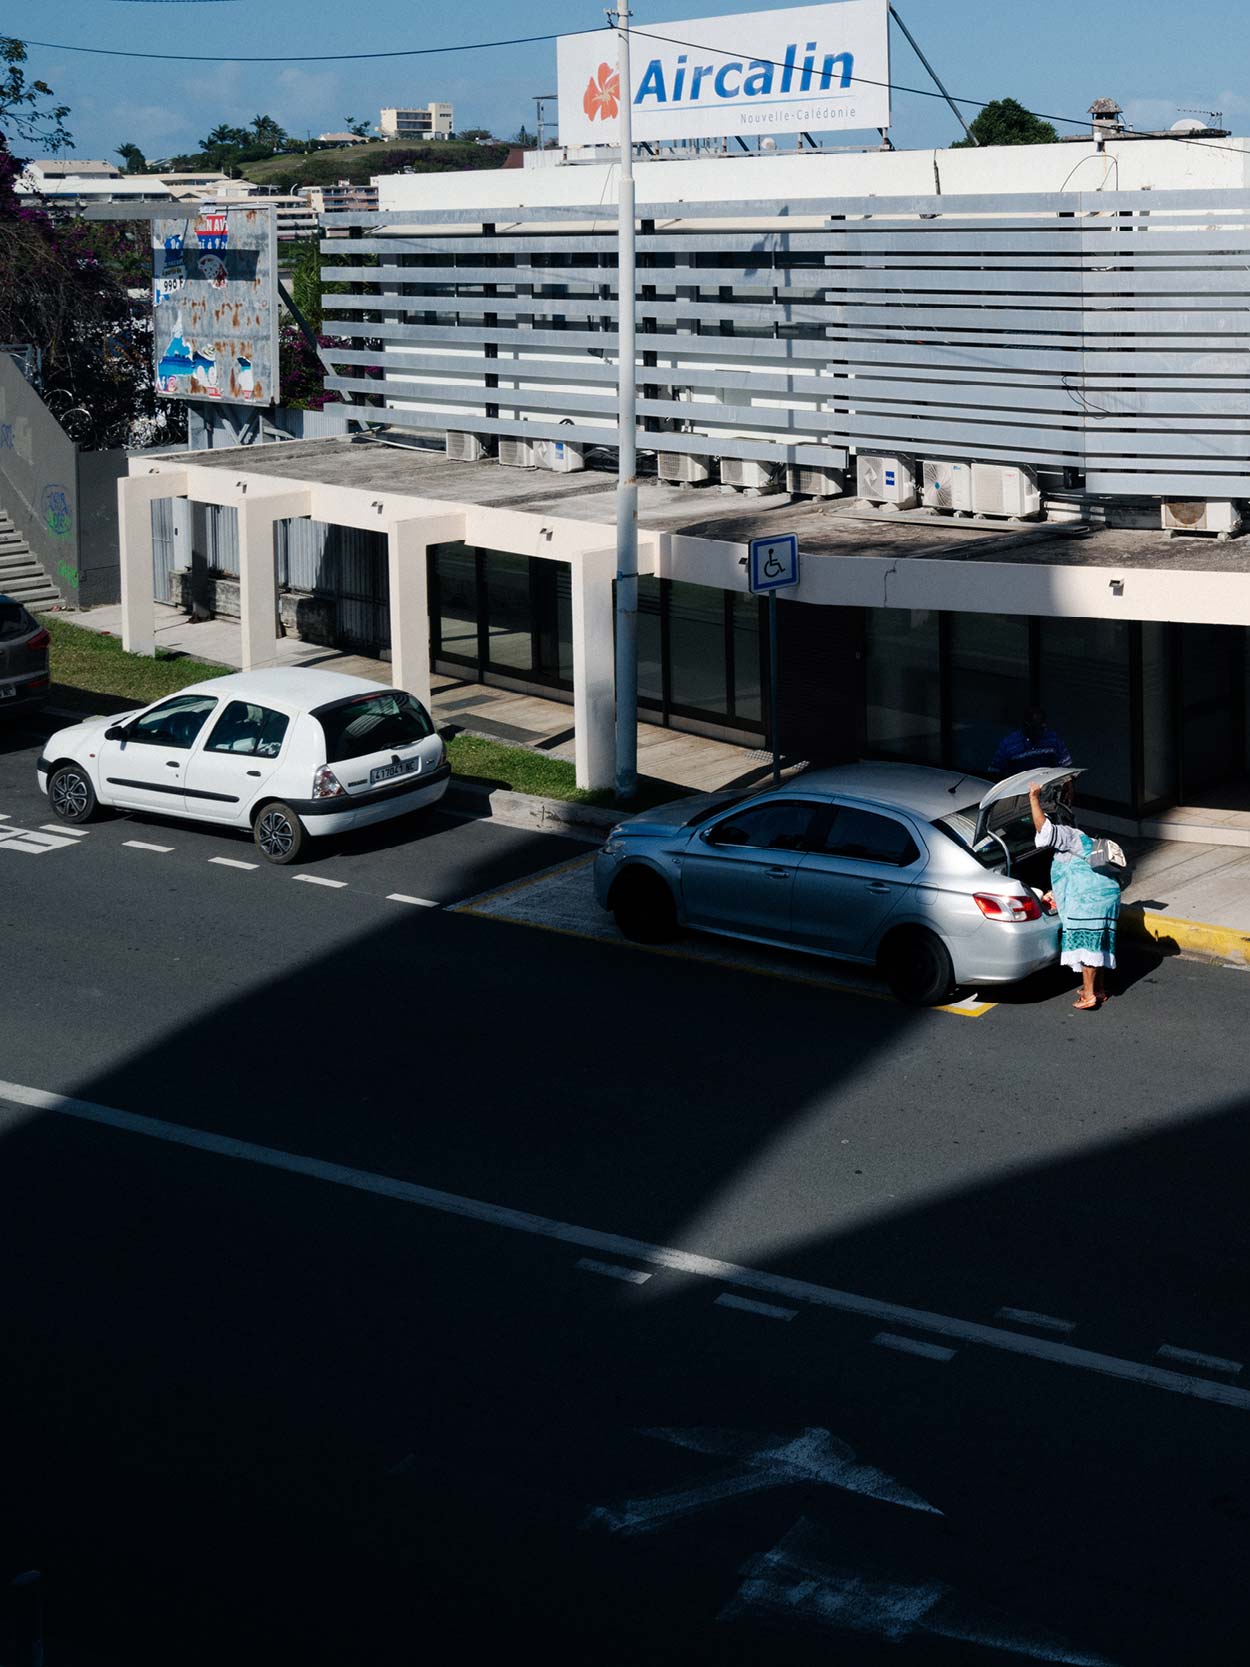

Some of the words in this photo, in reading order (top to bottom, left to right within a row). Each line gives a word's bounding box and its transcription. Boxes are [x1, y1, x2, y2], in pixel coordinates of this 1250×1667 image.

[633, 41, 855, 104] Aircalin
[740, 106, 856, 124] Nouvelle-Calédonie
[165, 279, 177, 292] 990
